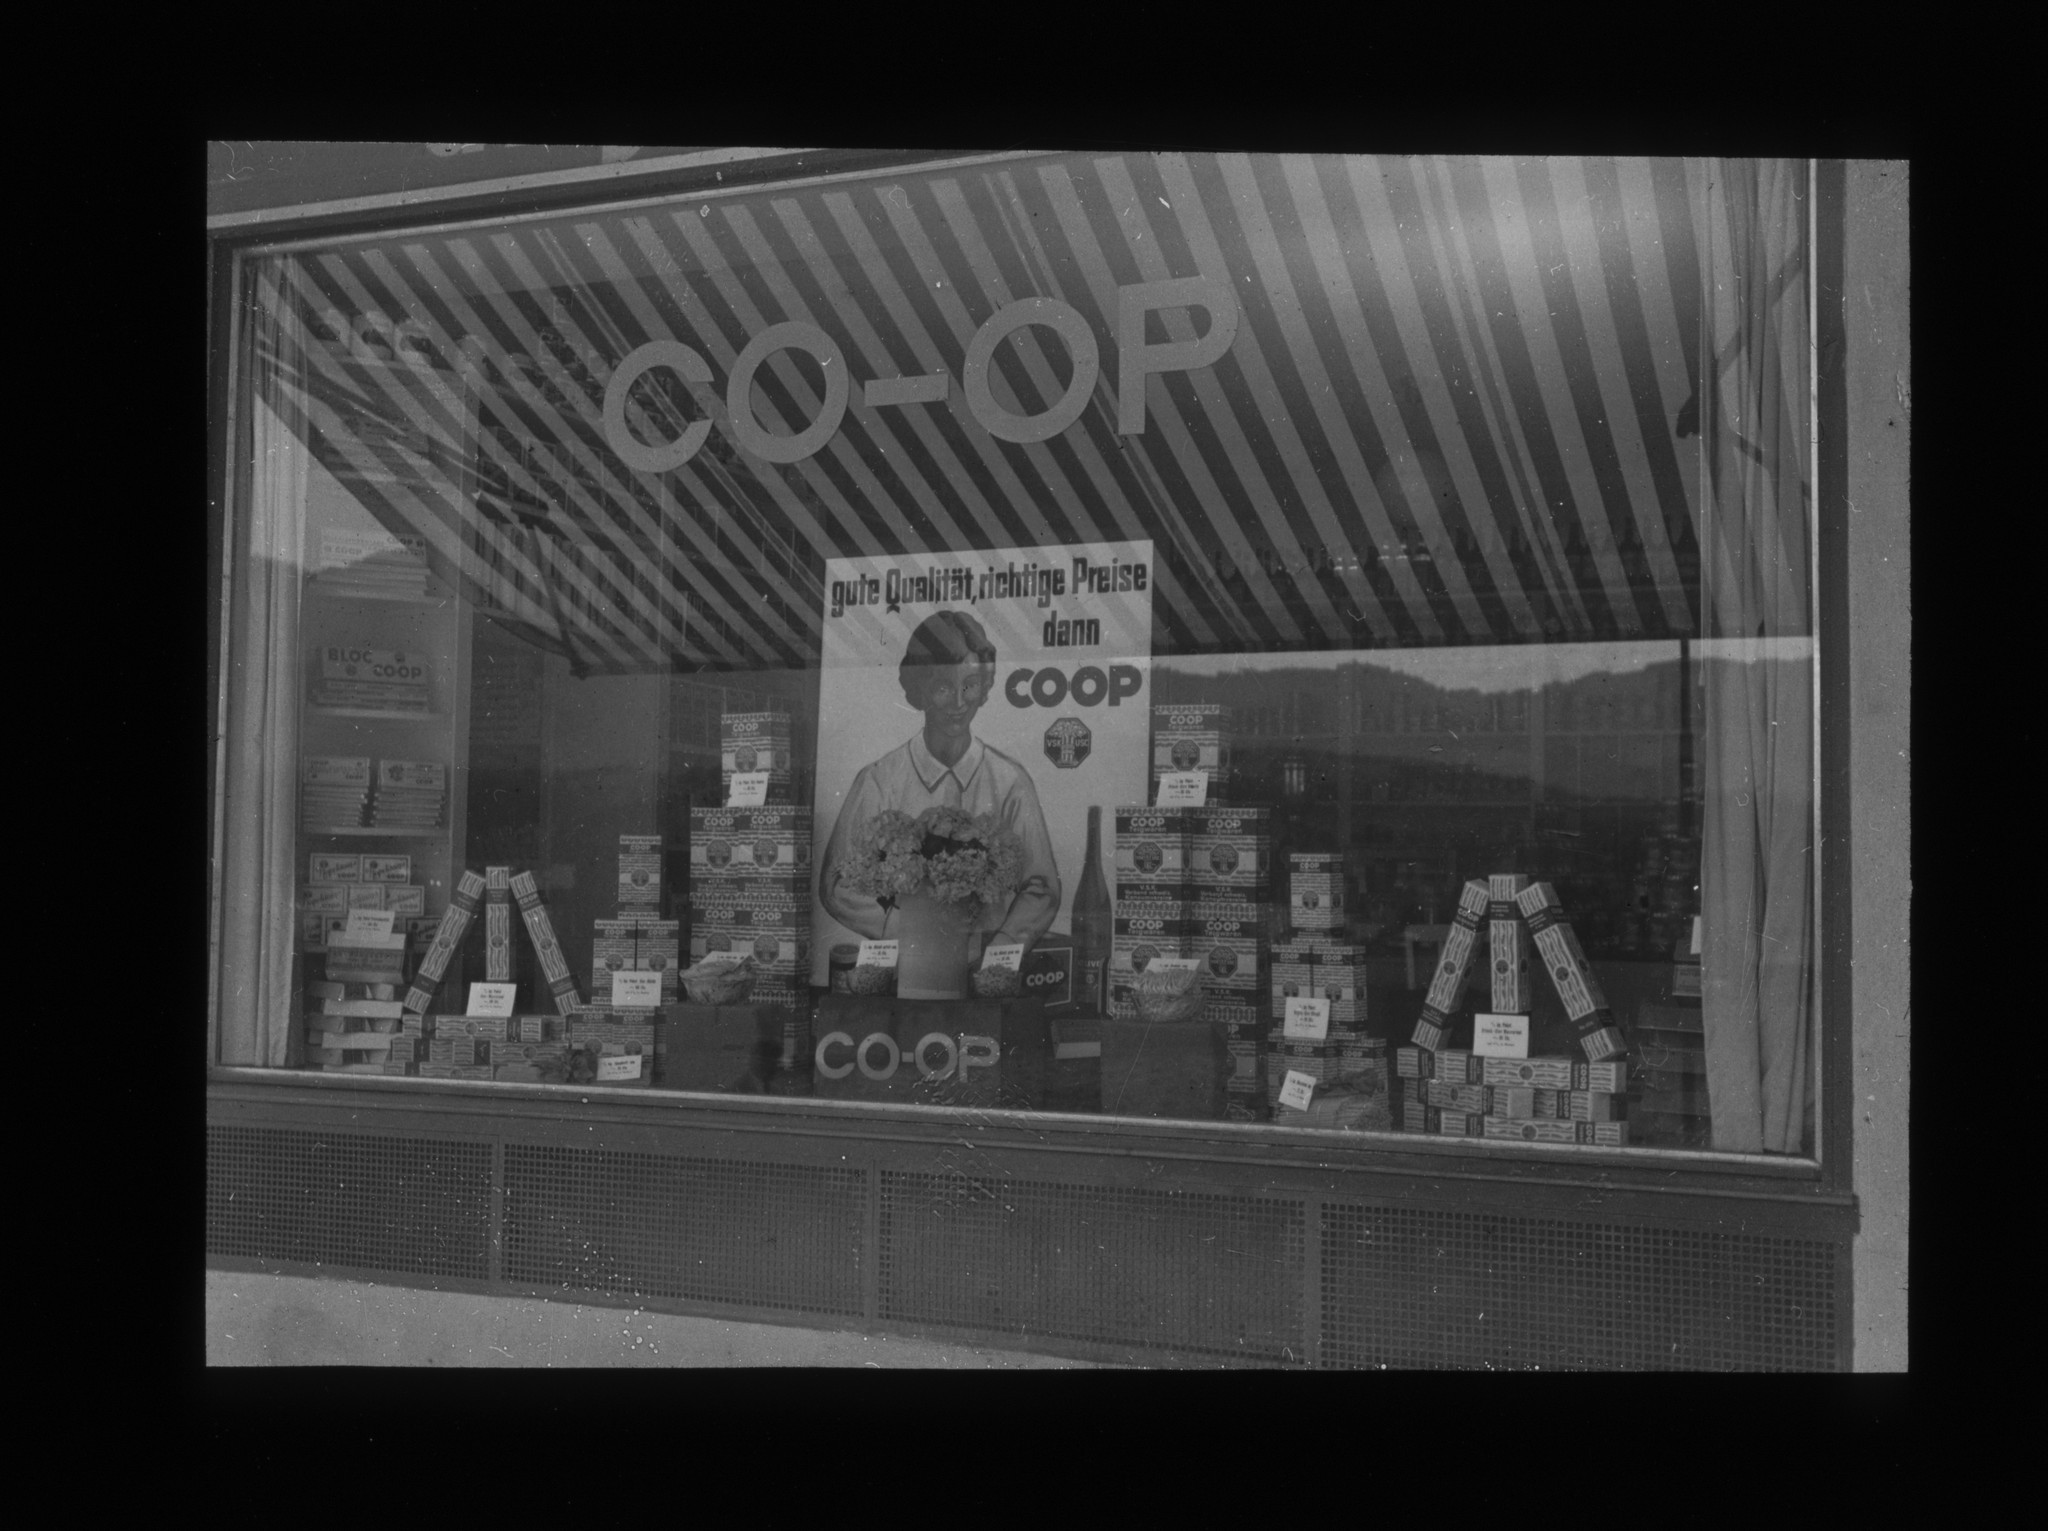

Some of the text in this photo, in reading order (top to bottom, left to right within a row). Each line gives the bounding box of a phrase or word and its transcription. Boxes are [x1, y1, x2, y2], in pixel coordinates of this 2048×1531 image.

[604, 272, 1239, 473] CO-OP
[831, 573, 880, 618] gute
[978, 561, 1066, 608] richtige
[1072, 556, 1147, 595] Preise
[328, 648, 372, 664] BLOC
[1042, 610, 1100, 648] dann
[815, 1031, 1001, 1085] CO-OP
